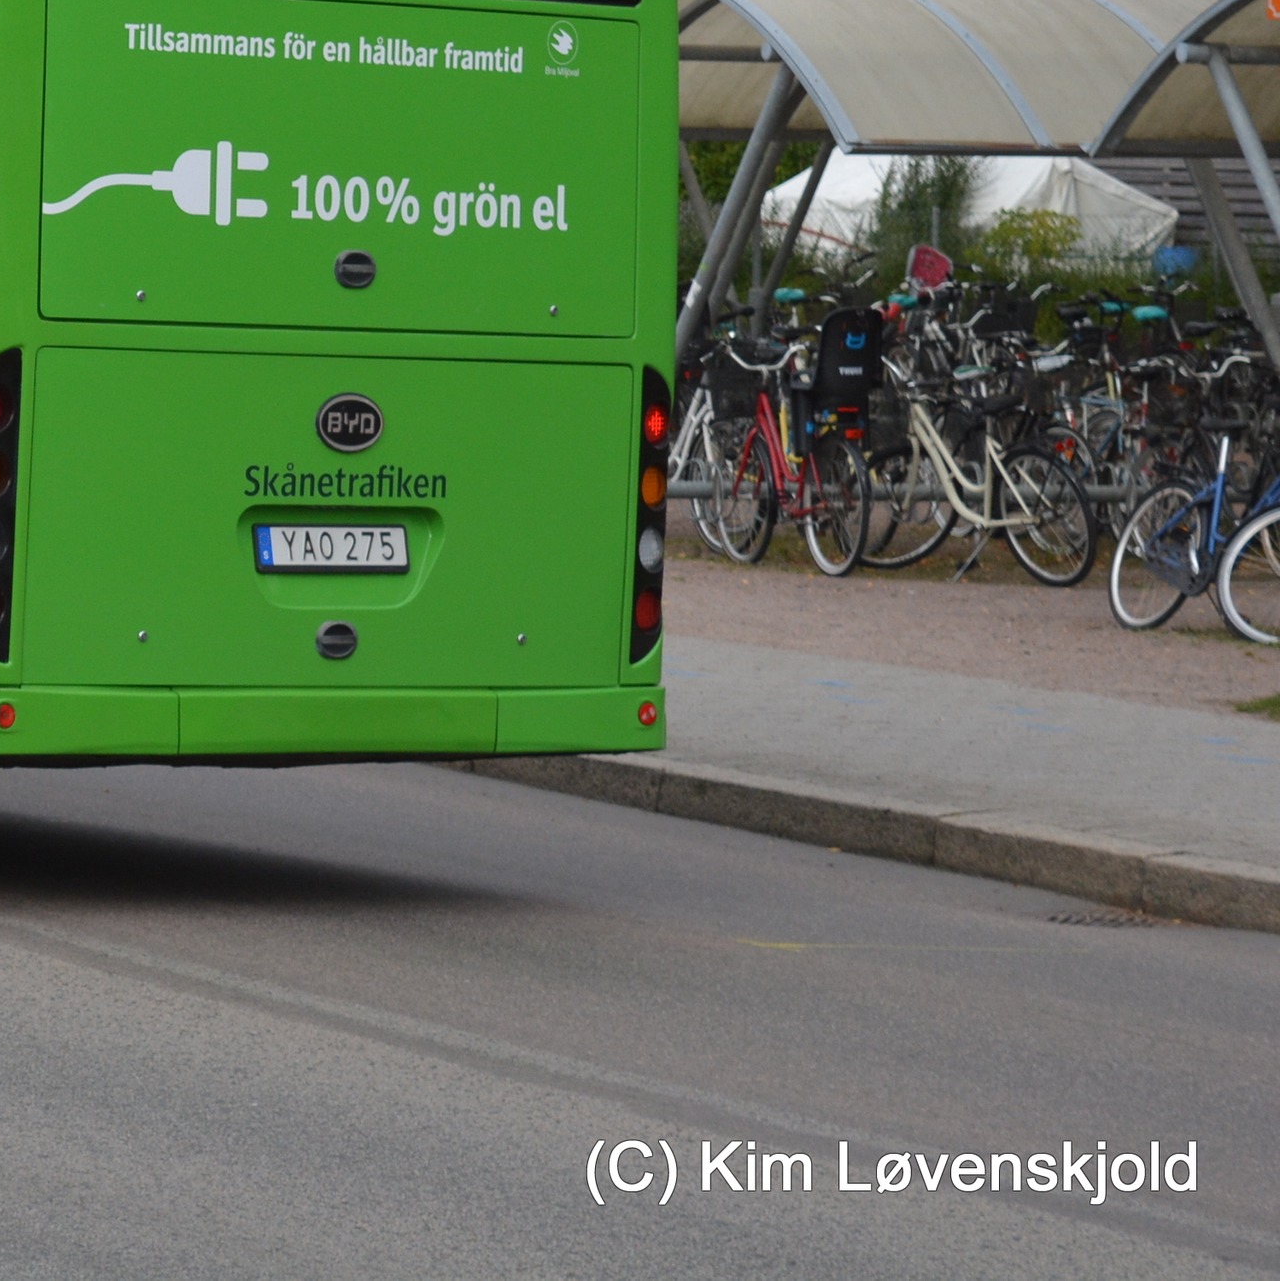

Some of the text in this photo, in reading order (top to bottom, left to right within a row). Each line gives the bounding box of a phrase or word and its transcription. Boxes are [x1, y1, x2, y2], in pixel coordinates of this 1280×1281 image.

[124, 22, 524, 74] Tillsammans för en hållbar framtid
[433, 182, 521, 236] grön
[532, 184, 568, 231] el
[327, 412, 375, 434] BYD
[244, 462, 447, 498] Skånetrafiken
[281, 530, 334, 561] YAO
[343, 531, 395, 561] 275
